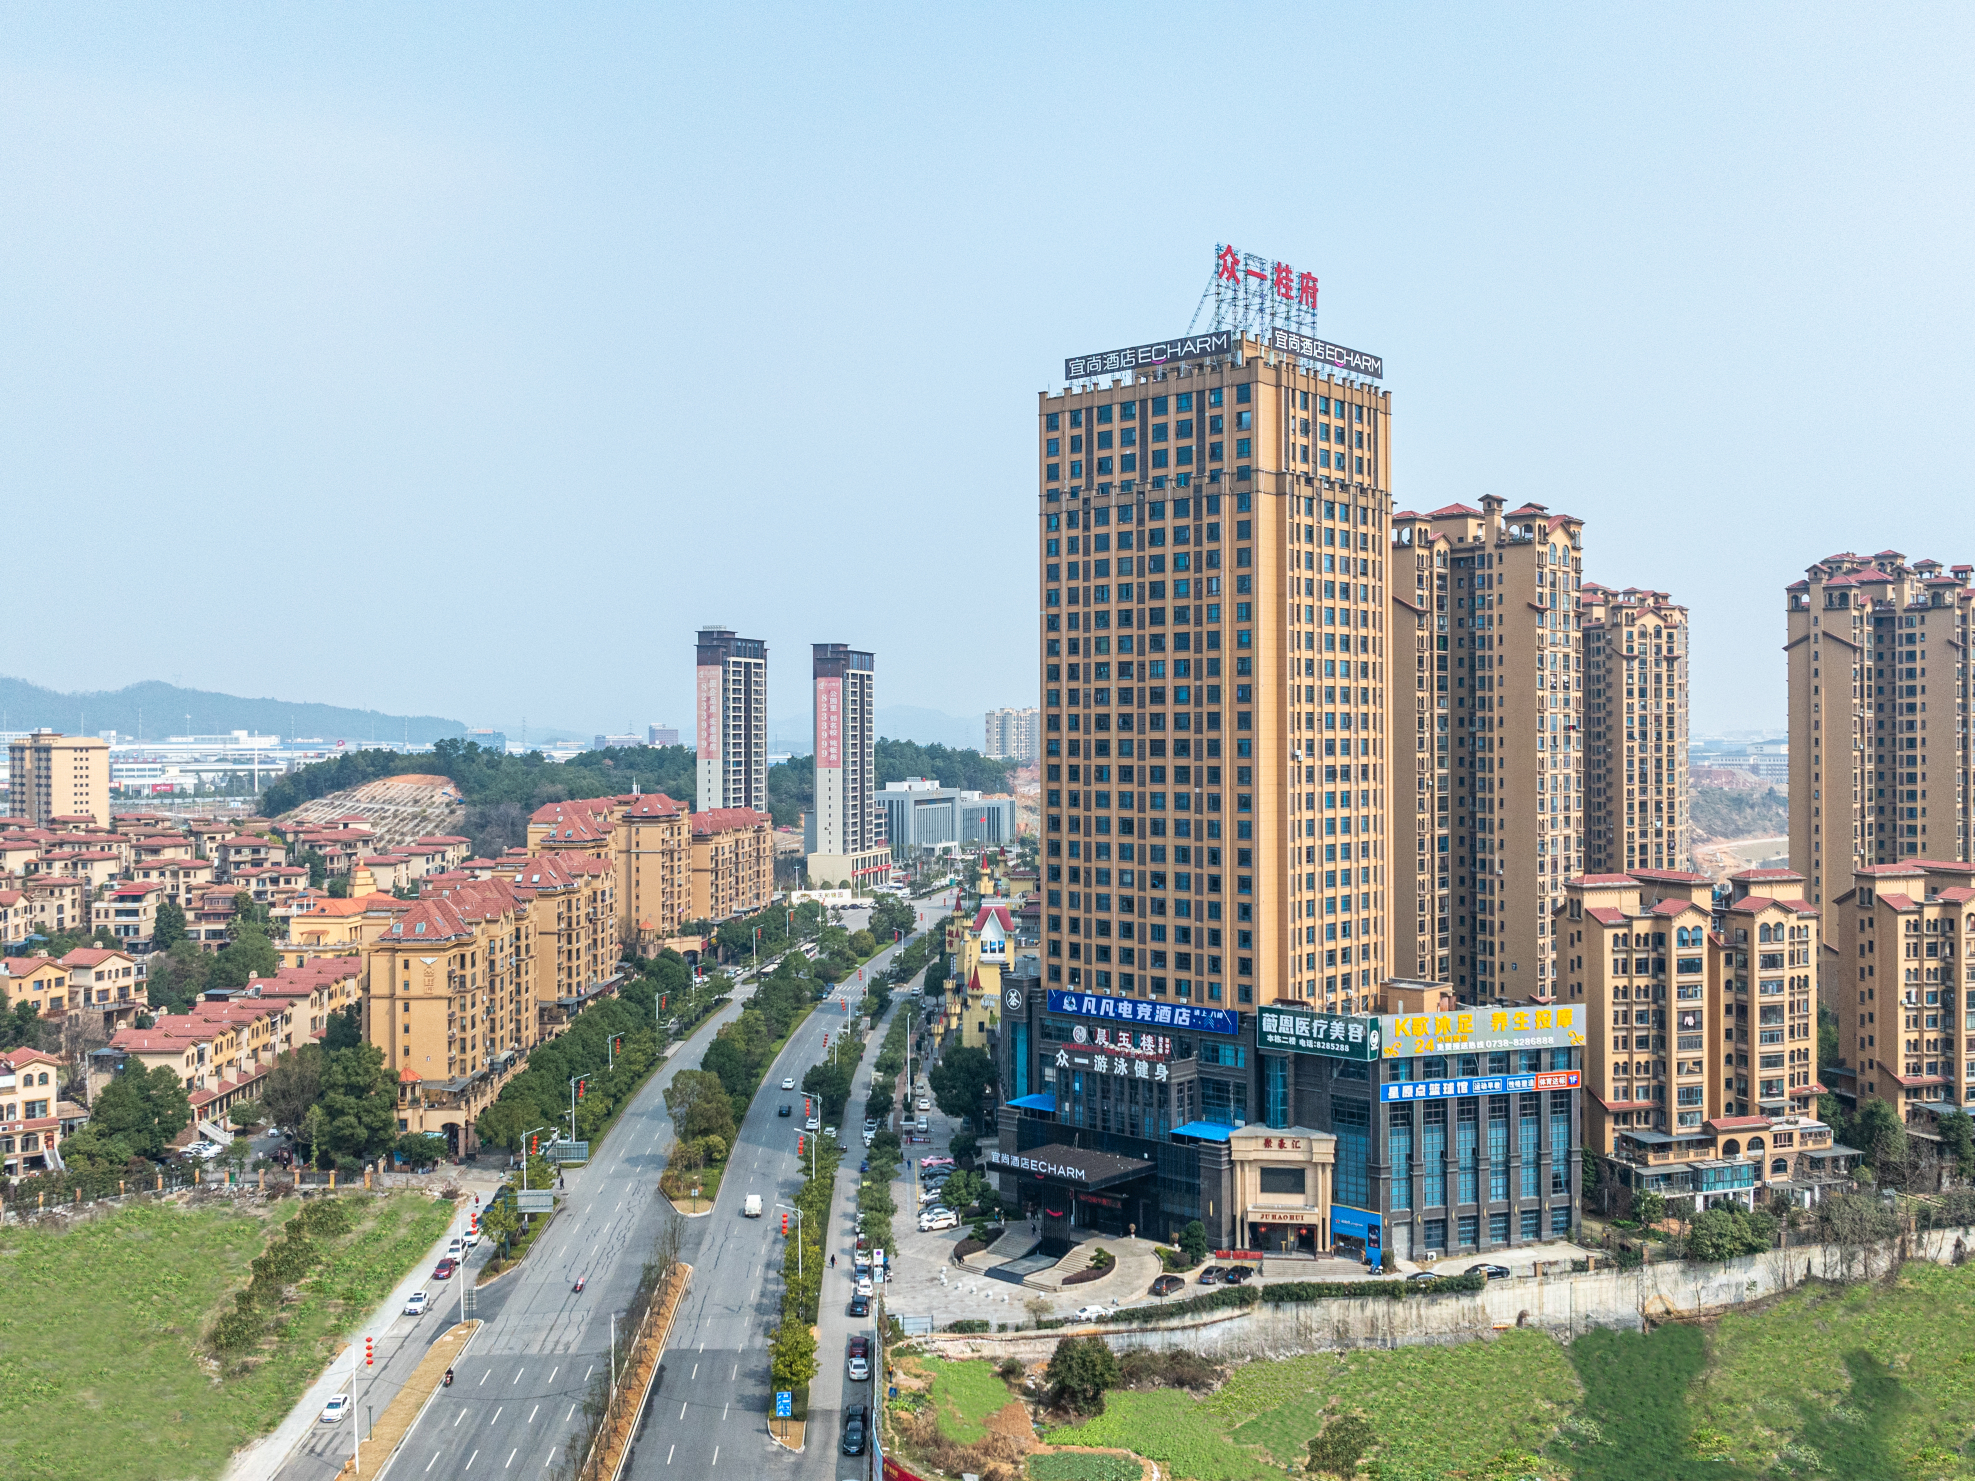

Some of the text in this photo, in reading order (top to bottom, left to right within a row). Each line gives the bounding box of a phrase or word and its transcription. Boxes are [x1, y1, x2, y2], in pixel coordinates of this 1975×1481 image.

[1219, 244, 1319, 309] 众一桂府
[946, 929, 954, 950] 超市
[1082, 997, 1191, 1026] 凡凡电竞酒店
[1491, 1008, 1574, 1032] 养生按摩
[1262, 1013, 1364, 1043] 薇恩医疗美容
[1415, 1038, 1435, 1053] 24
[1485, 1037, 1554, 1049] 0738-8286888
[1056, 1049, 1169, 1082] 众一游泳健身
[1569, 1076, 1578, 1084] 1F
